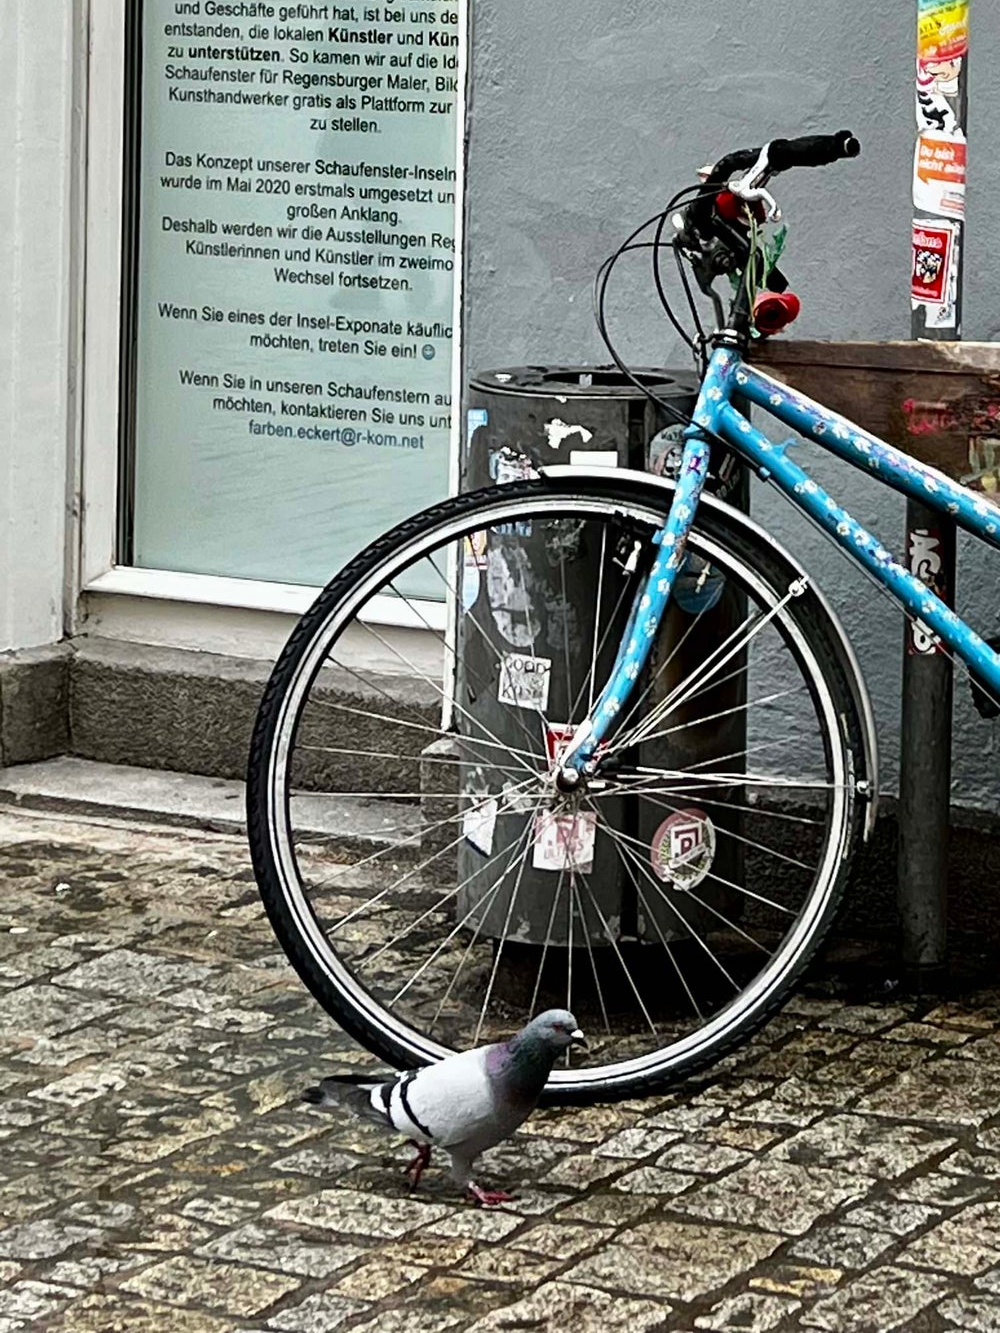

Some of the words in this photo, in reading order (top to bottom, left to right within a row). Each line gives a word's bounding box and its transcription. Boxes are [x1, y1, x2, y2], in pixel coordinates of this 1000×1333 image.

[175, 2, 199, 15] und
[205, 1, 274, 17] Geschäfte
[279, 4, 328, 20] geführt
[333, 6, 358, 22] hat,
[364, 7, 380, 21] ist
[385, 8, 405, 22] bei
[411, 12, 436, 24] uns
[165, 23, 244, 40] entstanden,
[249, 24, 269, 39] die
[274, 26, 323, 41] lokalen
[329, 27, 393, 44] Künstler
[397, 31, 423, 45] und
[168, 46, 183, 58] zu
[189, 46, 284, 62] unterstützen.
[289, 48, 308, 63] So
[314, 50, 360, 65] kamen
[365, 52, 385, 66] wir
[390, 53, 413, 67] auf
[416, 53, 437, 68] die
[165, 65, 255, 83] Schaufenster
[260, 68, 278, 84] für
[283, 70, 383, 91] Regensburger
[387, 74, 429, 92] Maler,
[169, 87, 289, 106] Kunsthandwerker
[293, 94, 331, 110] gratis
[336, 95, 356, 109] als
[361, 95, 424, 113] Plattform
[429, 102, 452, 114] zur
[310, 118, 326, 130] zu
[331, 117, 381, 133] stellen.
[166, 152, 192, 167] Das
[197, 153, 252, 173] Konzept
[257, 160, 310, 173] unserer
[315, 159, 456, 182] Schaufenster-Inseln
[161, 175, 201, 189] wurde
[207, 176, 222, 190] im
[227, 177, 251, 192] Mai
[256, 178, 290, 195] 2020
[295, 183, 354, 198] erstmals
[359, 188, 433, 203] umgesetzt
[287, 203, 336, 221] großen
[341, 205, 402, 227] Anklang.
[162, 217, 217, 234] Deshalb
[222, 222, 272, 238] werden
[277, 225, 297, 239] wir
[301, 226, 322, 241] die
[326, 227, 426, 250] Ausstellungen
[186, 240, 279, 260] Künstlerinnen
[285, 248, 310, 262] und
[316, 248, 373, 265] Künstler
[378, 252, 394, 267] im
[274, 267, 333, 285] Wechsel
[339, 271, 412, 291] fortsetzen.
[158, 302, 197, 320] Wenn
[202, 306, 223, 322] Sie
[228, 309, 265, 325] eines
[270, 312, 292, 327] der
[297, 313, 402, 335] Insel-Exponate
[250, 334, 313, 353] möchten,
[319, 338, 359, 354] treten
[364, 340, 386, 356] Sie
[392, 344, 417, 359] ein!
[179, 370, 218, 387] Wenn
[223, 373, 245, 390] Sie
[250, 375, 261, 390] in
[266, 380, 322, 395] unseren
[327, 381, 429, 405] Schaufenstern
[213, 397, 276, 416] möchten,
[281, 400, 366, 422] kontaktieren
[372, 408, 394, 424] Sie
[399, 414, 424, 426] uns
[249, 419, 424, 449] farben.eckert@r-kom.net
